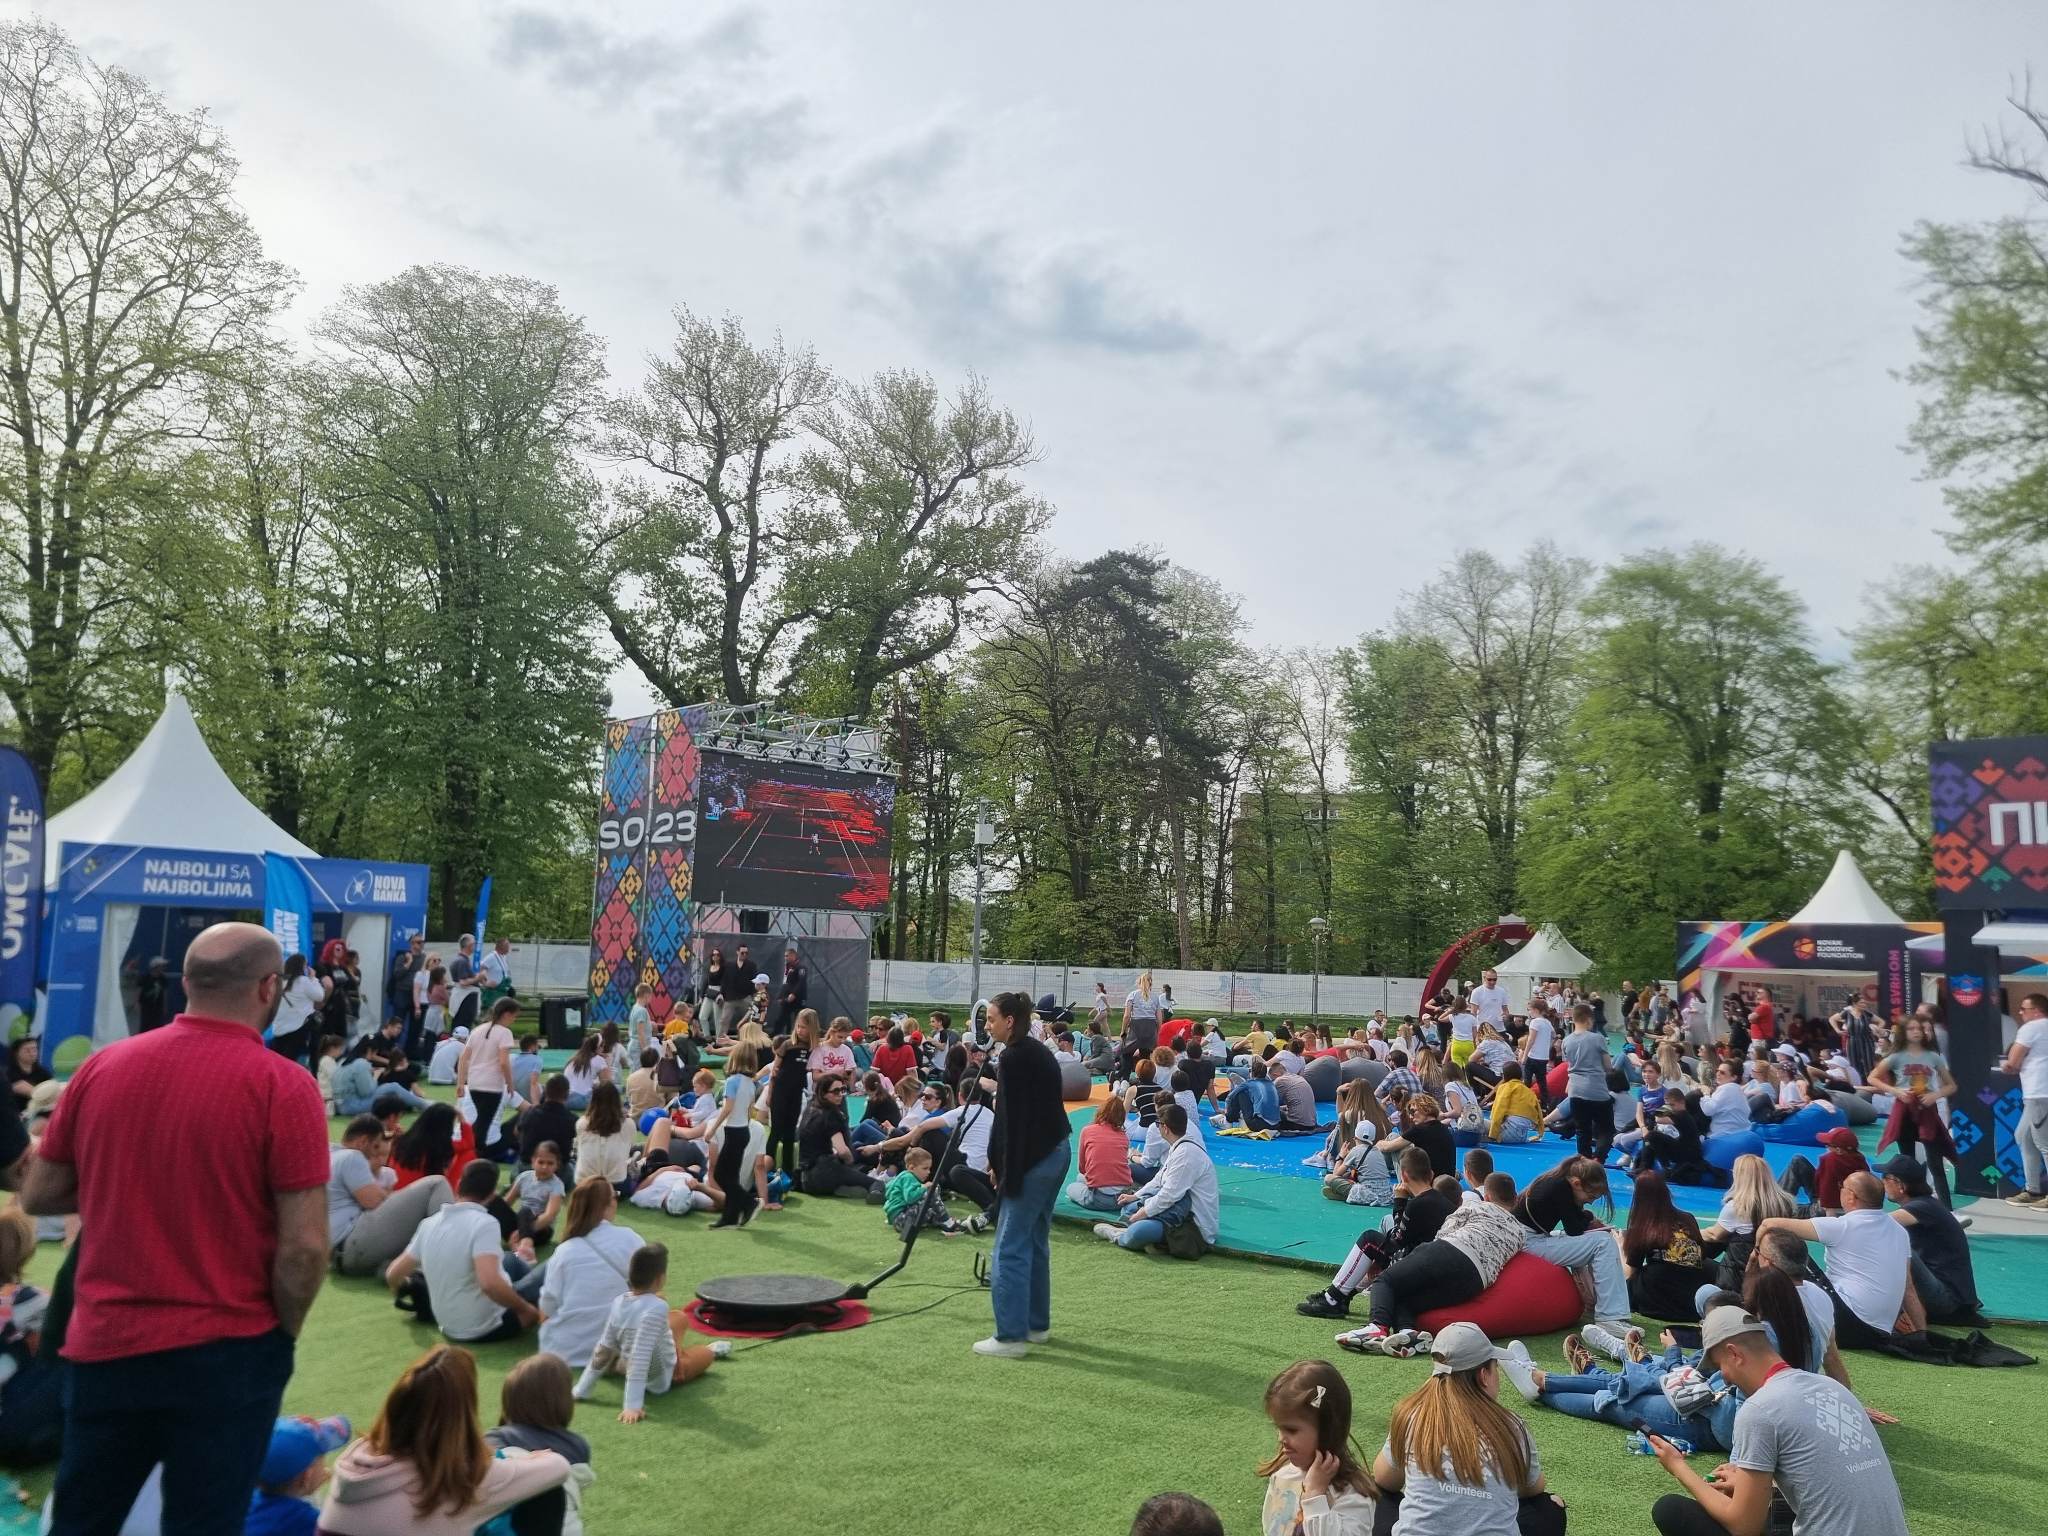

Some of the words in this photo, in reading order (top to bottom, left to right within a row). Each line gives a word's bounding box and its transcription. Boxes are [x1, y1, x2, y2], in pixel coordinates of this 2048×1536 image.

[600, 816, 645, 849] SO
[651, 809, 696, 843] 23
[144, 859, 227, 879] NAJBOLJI
[230, 864, 252, 881] SA
[142, 877, 253, 898] NAJBOLJIMA
[374, 875, 406, 890] NOVA
[372, 889, 407, 903] BANKA
[1439, 1481, 1493, 1500] Volunteers
